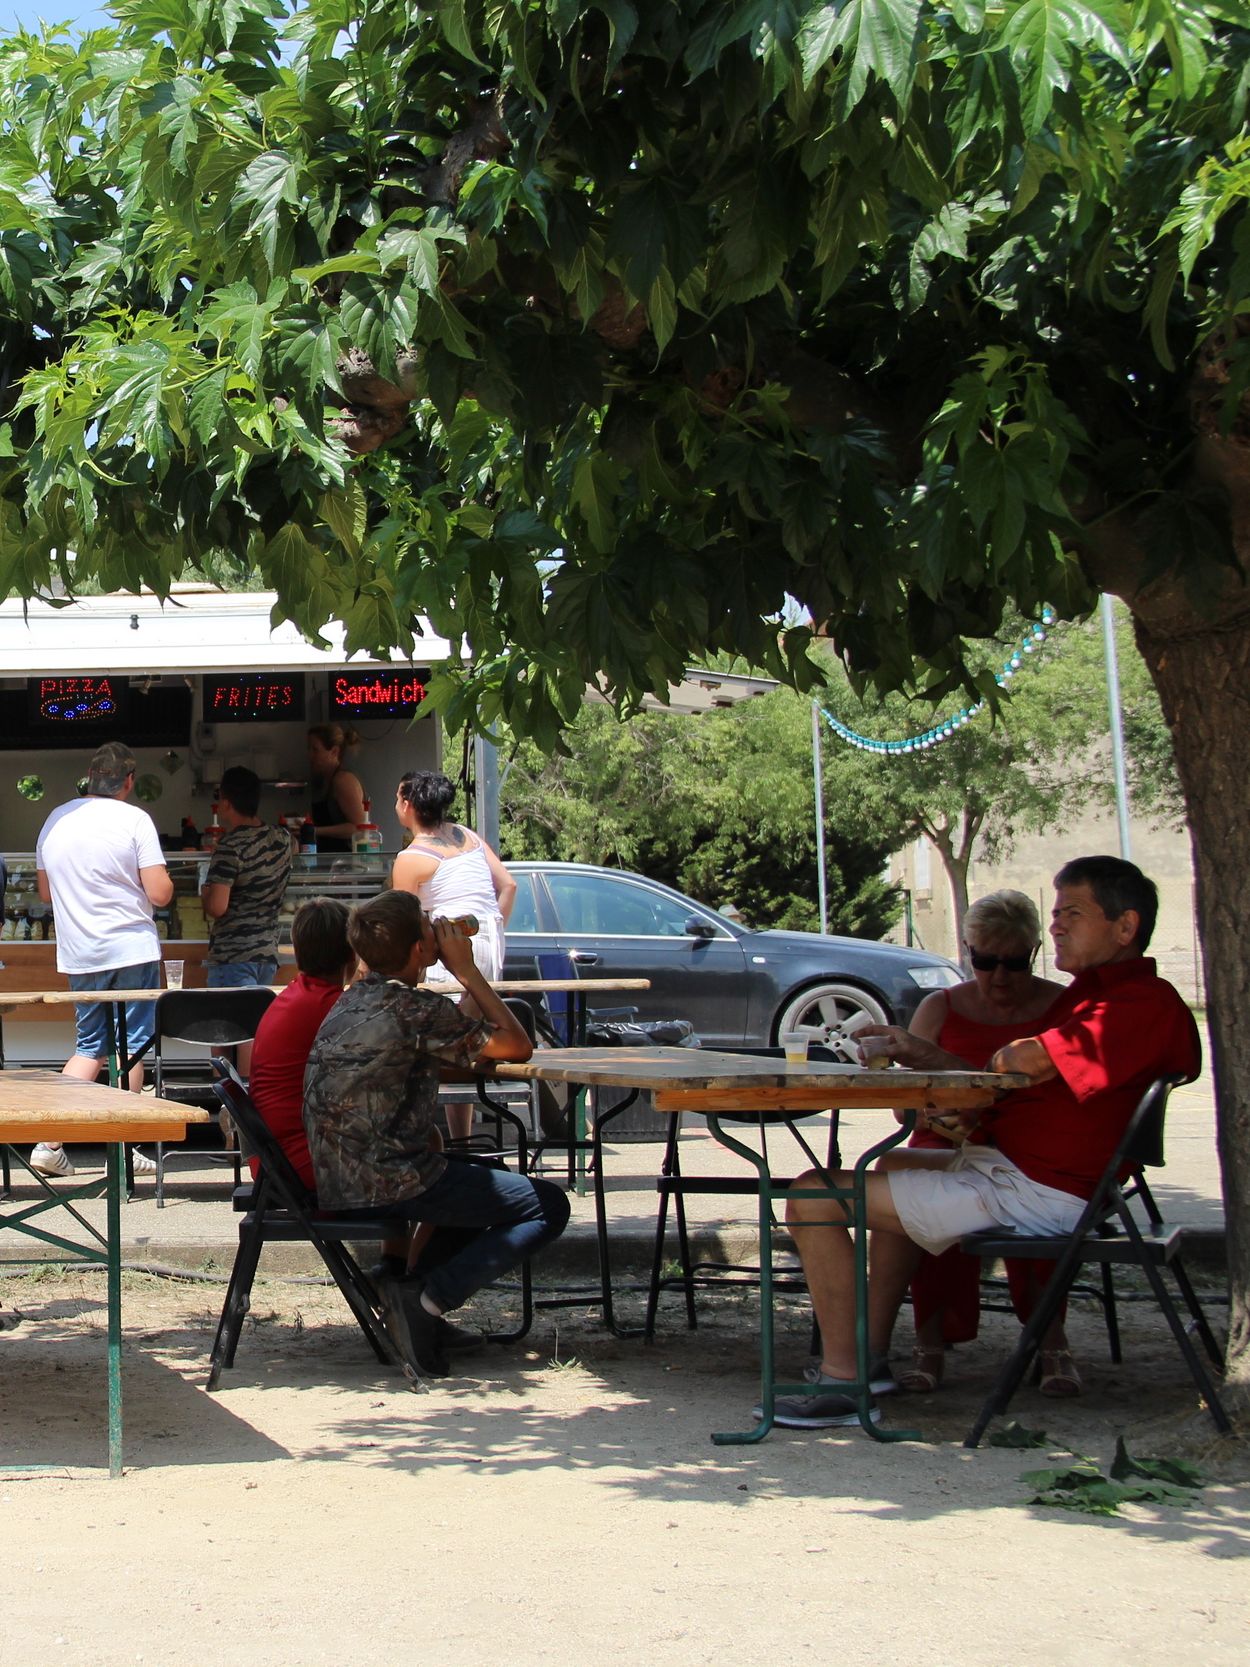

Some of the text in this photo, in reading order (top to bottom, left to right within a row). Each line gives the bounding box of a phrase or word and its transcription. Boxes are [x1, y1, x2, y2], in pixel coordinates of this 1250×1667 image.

[41, 679, 111, 699] PIZZA
[214, 686, 292, 706] FRITES
[335, 678, 426, 704] Sandwich
